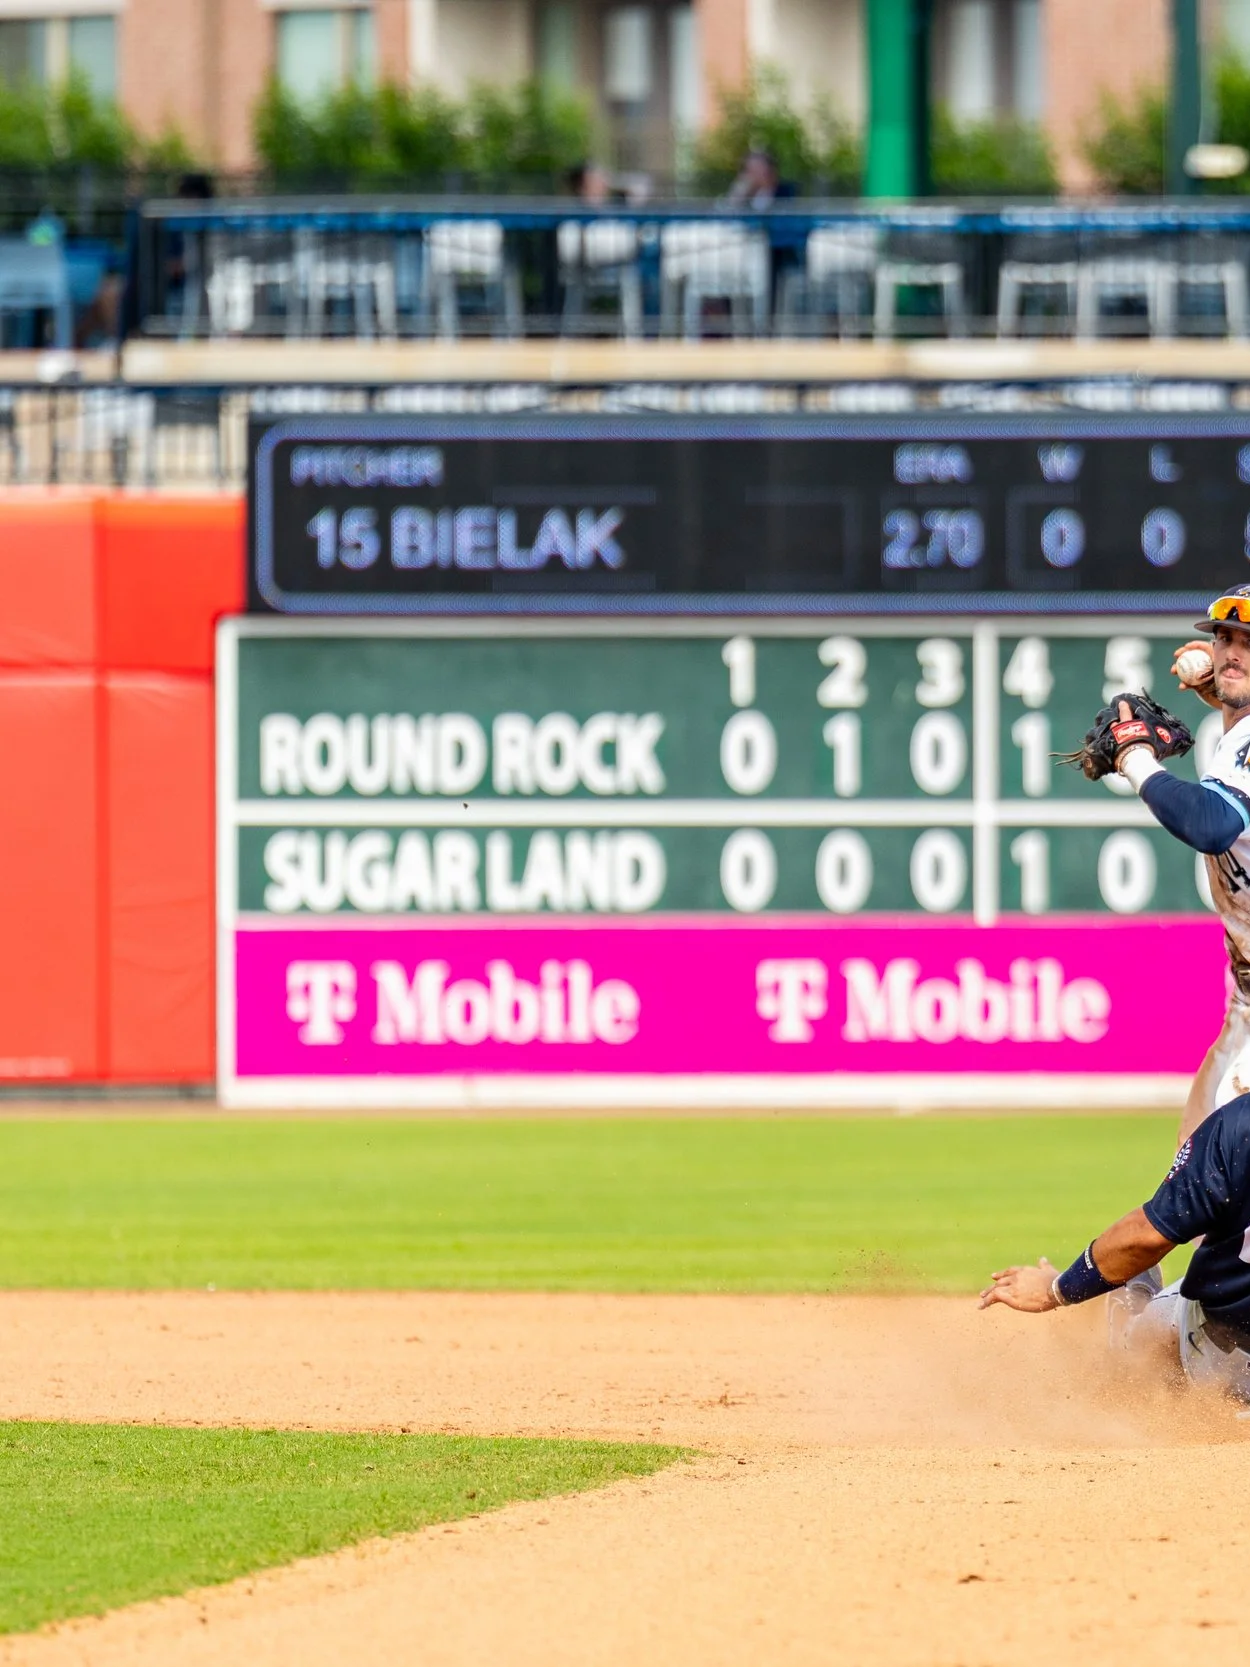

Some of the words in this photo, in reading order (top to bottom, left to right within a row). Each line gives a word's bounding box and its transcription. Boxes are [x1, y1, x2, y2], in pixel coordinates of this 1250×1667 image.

[291, 447, 442, 485] PITCHER
[895, 444, 972, 482] ERA
[1039, 443, 1083, 482] W
[1149, 443, 1182, 482] L
[307, 507, 380, 568] 15
[391, 507, 624, 568] BIELAK
[883, 508, 983, 568] 2.70
[1041, 507, 1085, 568] 0
[1142, 507, 1186, 568] 0
[722, 637, 756, 706] 1
[817, 637, 868, 706] 2
[916, 639, 965, 706] 3
[1004, 638, 1053, 706] 4
[1102, 637, 1153, 705] 5
[260, 713, 487, 795] ROUND
[493, 712, 666, 795] ROCK
[720, 710, 777, 794] 0
[823, 712, 861, 796] 1
[910, 710, 967, 794] 0
[1011, 712, 1051, 796] 1
[264, 829, 480, 913] SUGAR
[486, 829, 666, 913] LAND
[720, 828, 777, 912] 0
[815, 828, 872, 912] 0
[910, 828, 967, 912] 0
[1010, 829, 1050, 914] 1
[1099, 829, 1157, 913] 0
[286, 959, 356, 1045] T
[372, 959, 640, 1044] Mobile
[756, 957, 827, 1043] T
[842, 957, 1110, 1043] Mobile
